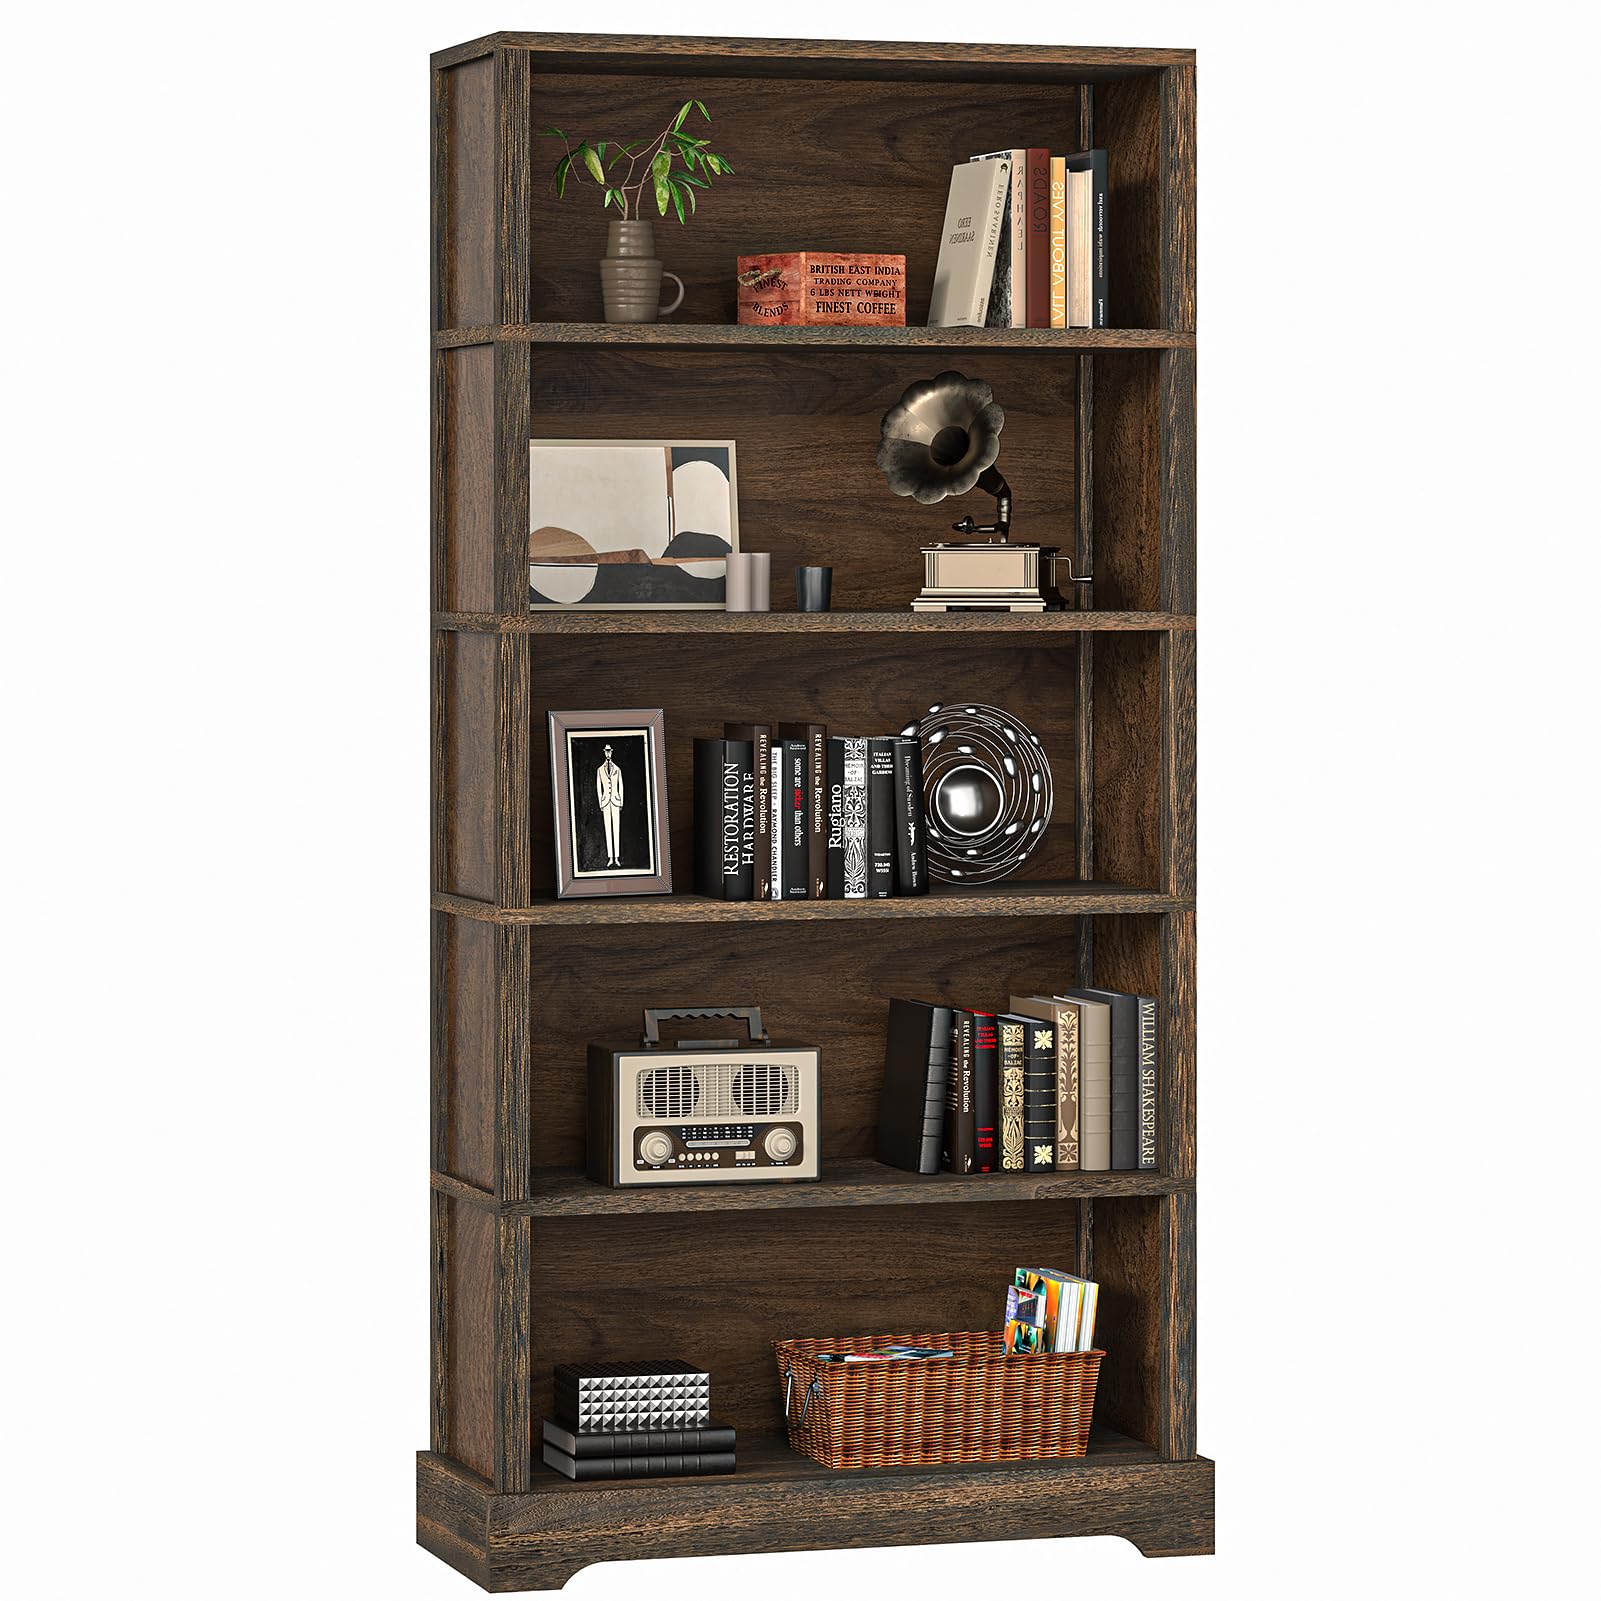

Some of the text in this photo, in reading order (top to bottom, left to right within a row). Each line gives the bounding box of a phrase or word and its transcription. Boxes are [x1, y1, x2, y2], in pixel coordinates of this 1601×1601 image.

[810, 264, 901, 276] BRITISH EAST INDIA
[752, 276, 789, 294] FINEST
[810, 288, 901, 299] 6 LBS NETT WEIGHT
[814, 278, 897, 288] TRADING COMPANY
[752, 301, 789, 318] BLENDS
[816, 301, 896, 315] FINEST COFFEE
[759, 734, 767, 775] REVEALING
[814, 733, 822, 774] REVEALING
[794, 757, 802, 776] some
[794, 776, 802, 788] are
[723, 762, 739, 876] RESTORATION
[742, 772, 754, 866] HARDWARE
[759, 788, 768, 834] Revolution
[794, 810, 803, 825] than
[814, 787, 822, 833] Revolution
[828, 784, 846, 849] Rugiano
[794, 825, 803, 847] others
[963, 1070, 971, 1113] Revolution
[1142, 1002, 1155, 1165] WILLIAM SHAKESPEARE
